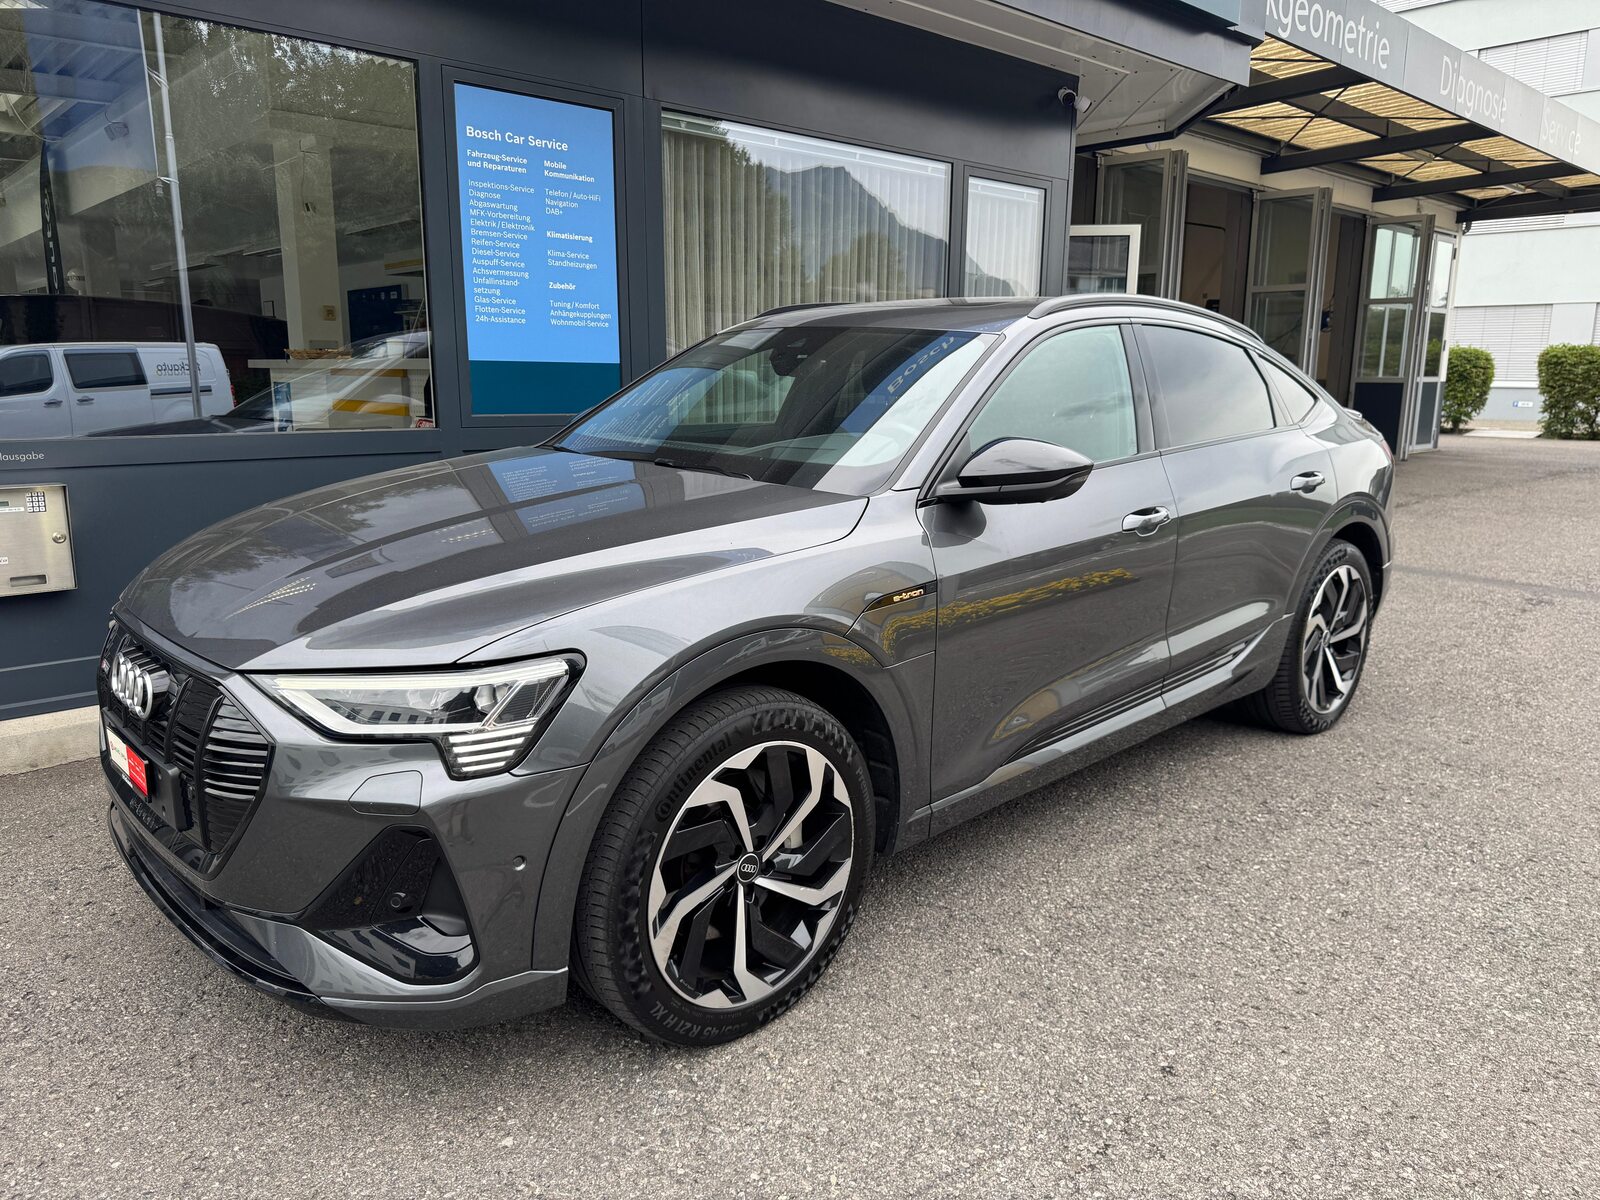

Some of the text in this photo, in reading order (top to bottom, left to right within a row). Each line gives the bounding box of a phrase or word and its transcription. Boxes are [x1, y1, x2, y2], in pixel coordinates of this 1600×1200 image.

[1440, 55, 1507, 123] Diagnose
[466, 125, 568, 151] Bosch Car Service
[467, 149, 528, 165] Fahrzeug-Service
[467, 160, 527, 174] und Reparaturen
[543, 160, 567, 170] Mobile
[544, 169, 595, 183] Kommunikation
[468, 179, 535, 194] Inspektions-Service
[468, 188, 501, 200] Diagnose
[469, 199, 518, 212] Abgaswartung
[545, 198, 579, 209] Navigation
[470, 208, 531, 223] MFK-Vorbereitung
[545, 207, 563, 216] DAB+
[471, 228, 528, 241] Bremsen-Service
[546, 231, 593, 243] Klimatisierung
[471, 238, 520, 249] Reifen-Service
[472, 247, 520, 258] Diesel-Service
[547, 249, 590, 260] Klima-Service
[472, 257, 526, 268] Auspuff-Service
[547, 259, 598, 270] Standheizungen
[472, 267, 529, 279] Achsvermessung
[473, 287, 501, 296] setzung
[549, 282, 576, 290] Zubehör
[474, 296, 517, 305] Glas-Service
[474, 305, 526, 315] Flotten-Service
[550, 309, 612, 320] Anhängekupplungen
[475, 314, 527, 324] 24h-Assistance
[550, 318, 609, 328] Wohnmobil-Service
[893, 588, 924, 602] e-tron
